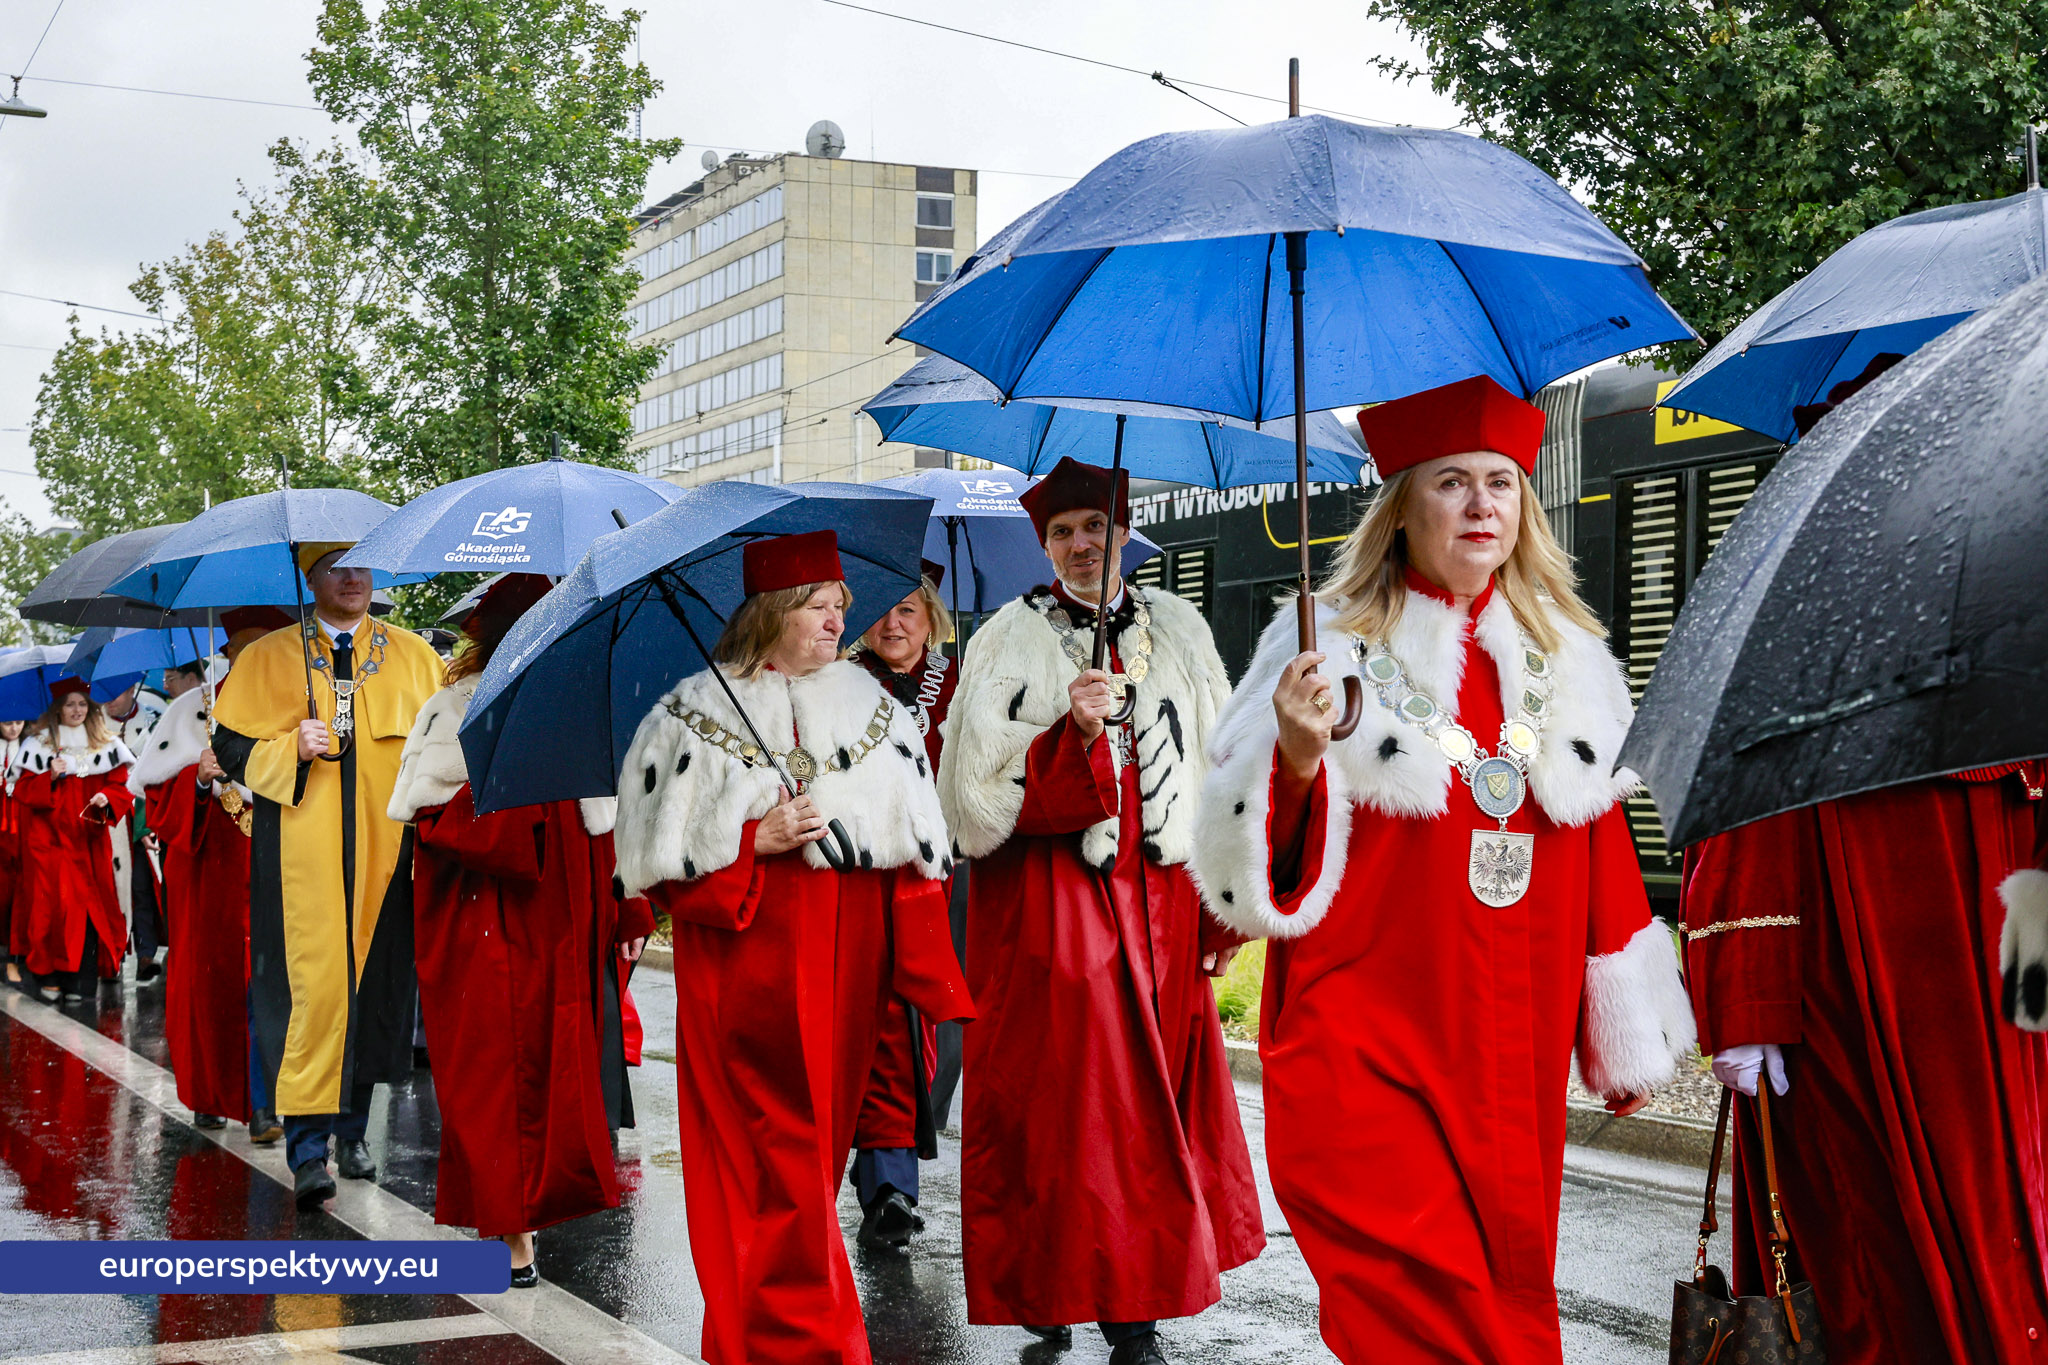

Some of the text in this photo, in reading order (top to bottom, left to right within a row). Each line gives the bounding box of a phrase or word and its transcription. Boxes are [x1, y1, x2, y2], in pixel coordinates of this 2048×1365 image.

[962, 496, 1021, 505] Akademi
[956, 502, 1025, 512] Górnośląs
[1128, 491, 1170, 528] ENT
[455, 542, 526, 553] Akademia
[444, 552, 531, 565] Górnośląska
